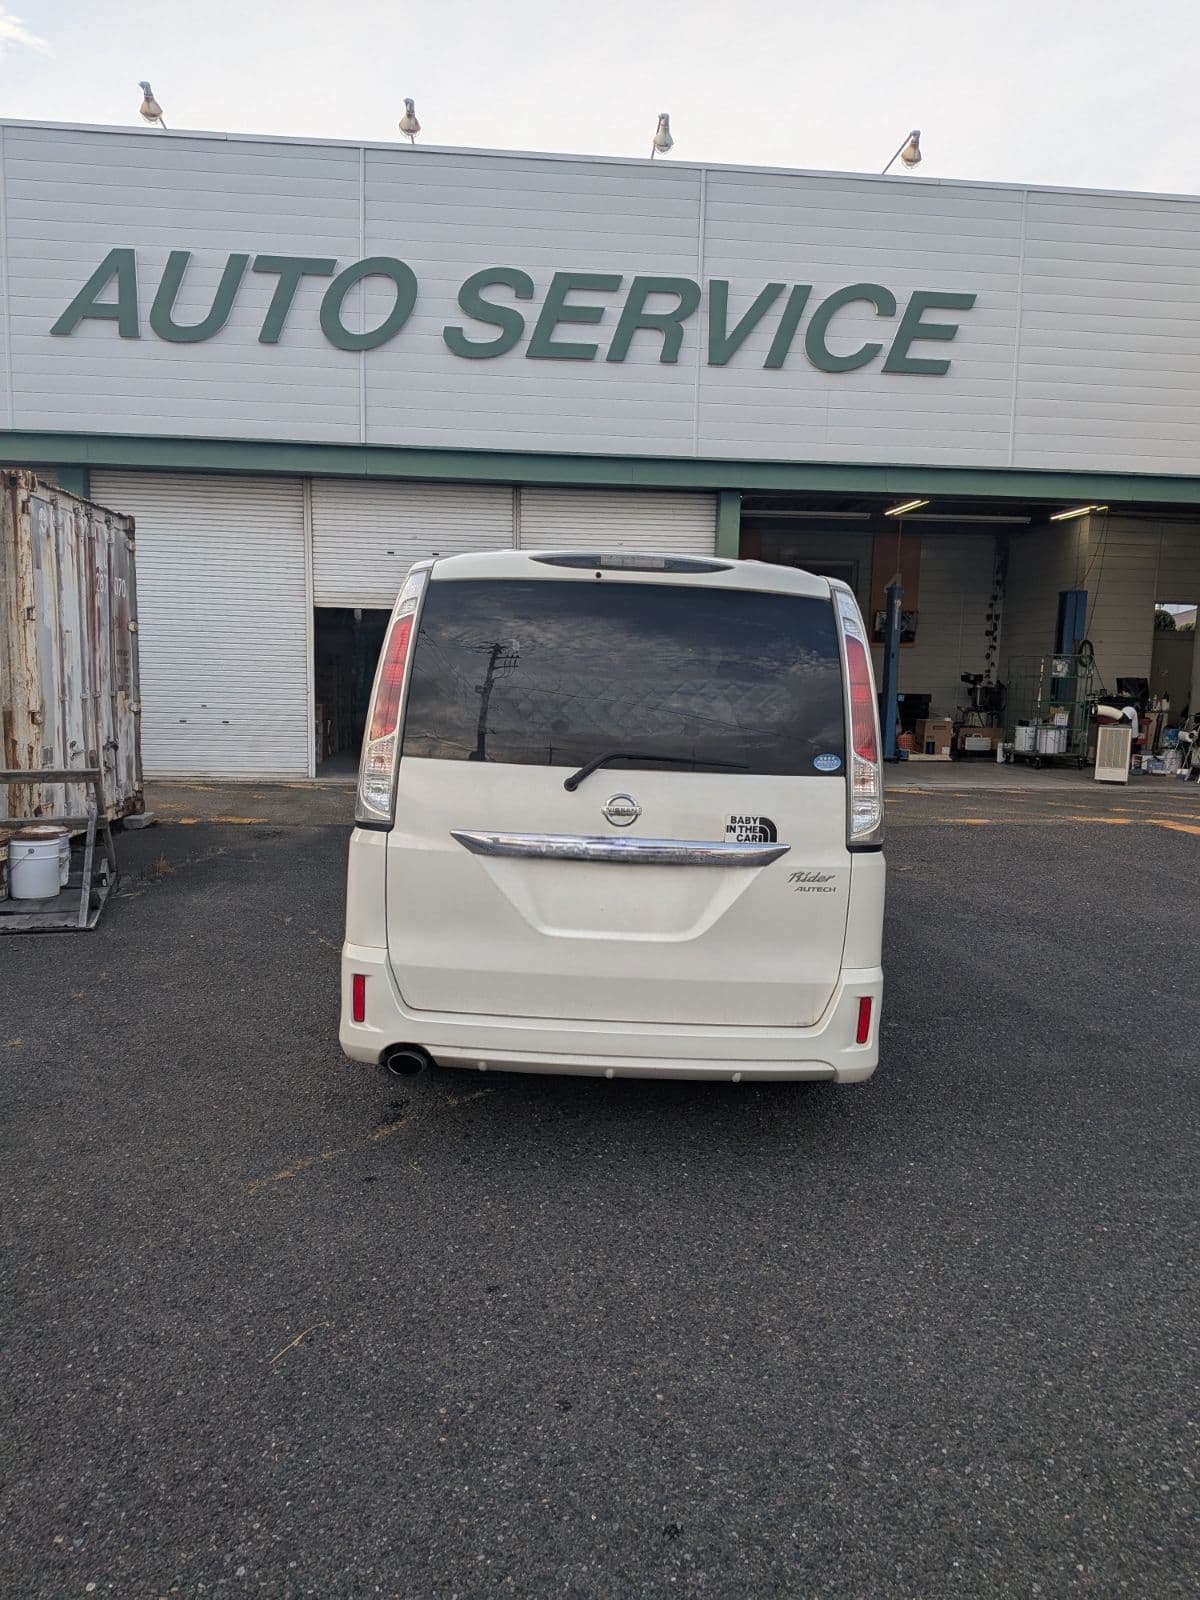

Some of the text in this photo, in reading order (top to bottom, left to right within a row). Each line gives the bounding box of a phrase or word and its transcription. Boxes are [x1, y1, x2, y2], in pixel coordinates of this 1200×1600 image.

[50, 247, 978, 375] AUTO SERVICE
[605, 806, 640, 816] NISSAN
[730, 815, 759, 825] BABY
[726, 825, 759, 834] IN THE
[736, 833, 758, 843] CAR
[787, 871, 836, 883] Rider
